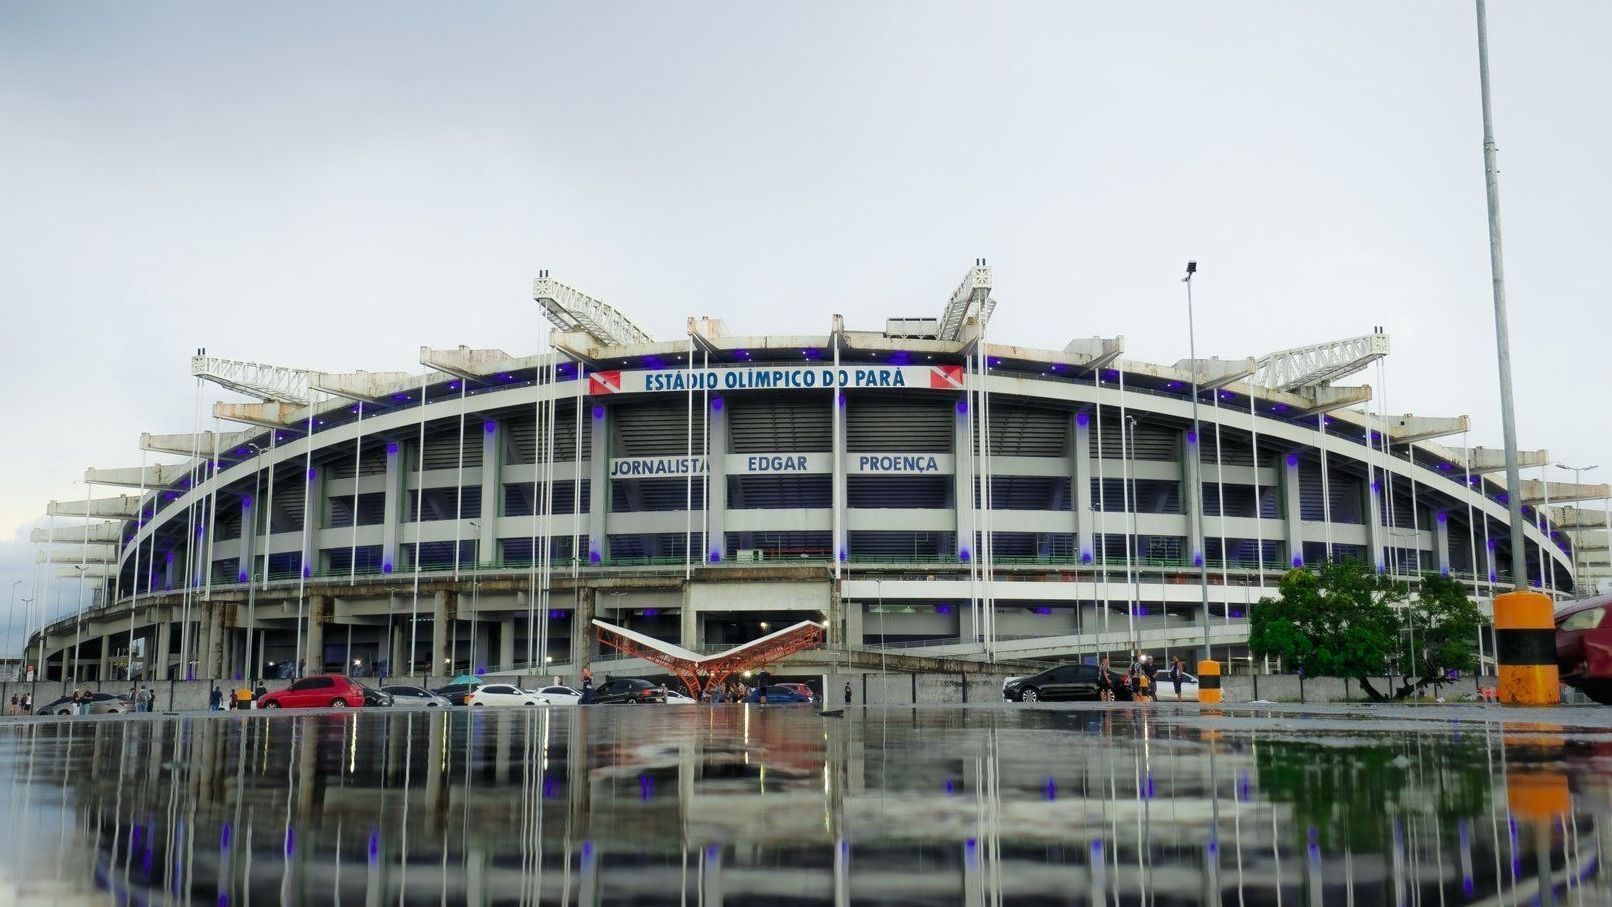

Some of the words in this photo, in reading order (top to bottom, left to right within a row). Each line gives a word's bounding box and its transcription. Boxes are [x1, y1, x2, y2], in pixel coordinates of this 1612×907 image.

[645, 370, 718, 391] ESTÁDIO
[724, 368, 816, 389] OLÍMPICO
[822, 369, 849, 387] DO
[855, 367, 905, 387] PARÁ
[611, 458, 710, 476] JORNALISTA
[748, 456, 807, 471] EDGAR
[859, 456, 938, 473] PROENÇA
